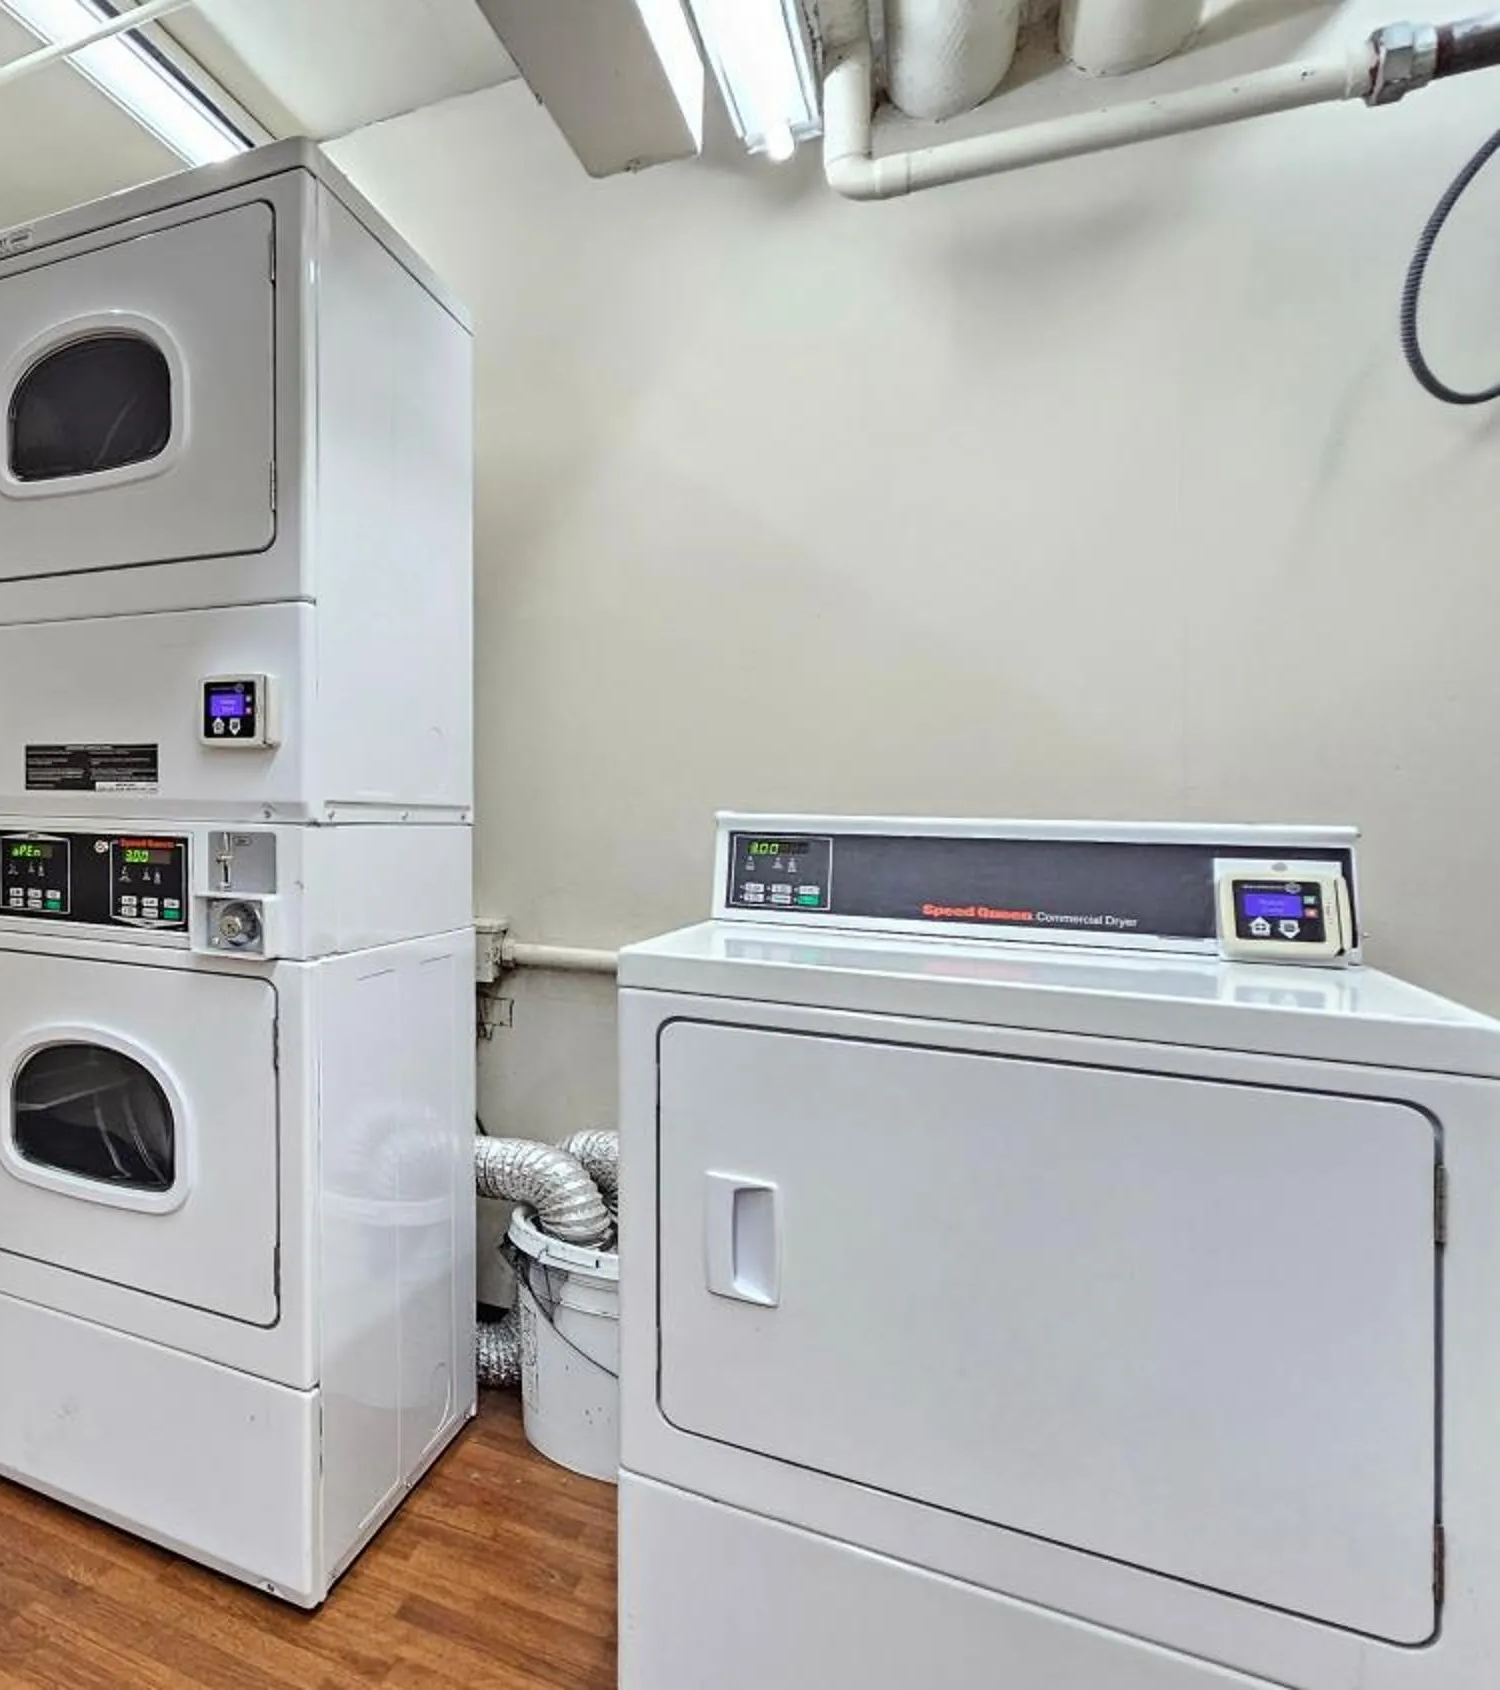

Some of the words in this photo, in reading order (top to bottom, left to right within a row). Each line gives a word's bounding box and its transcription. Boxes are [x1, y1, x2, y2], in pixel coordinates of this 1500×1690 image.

[921, 903, 975, 917] Speed
[977, 906, 1034, 921] Queen
[1035, 911, 1103, 926] Commercial
[1105, 915, 1138, 929] Dryer
